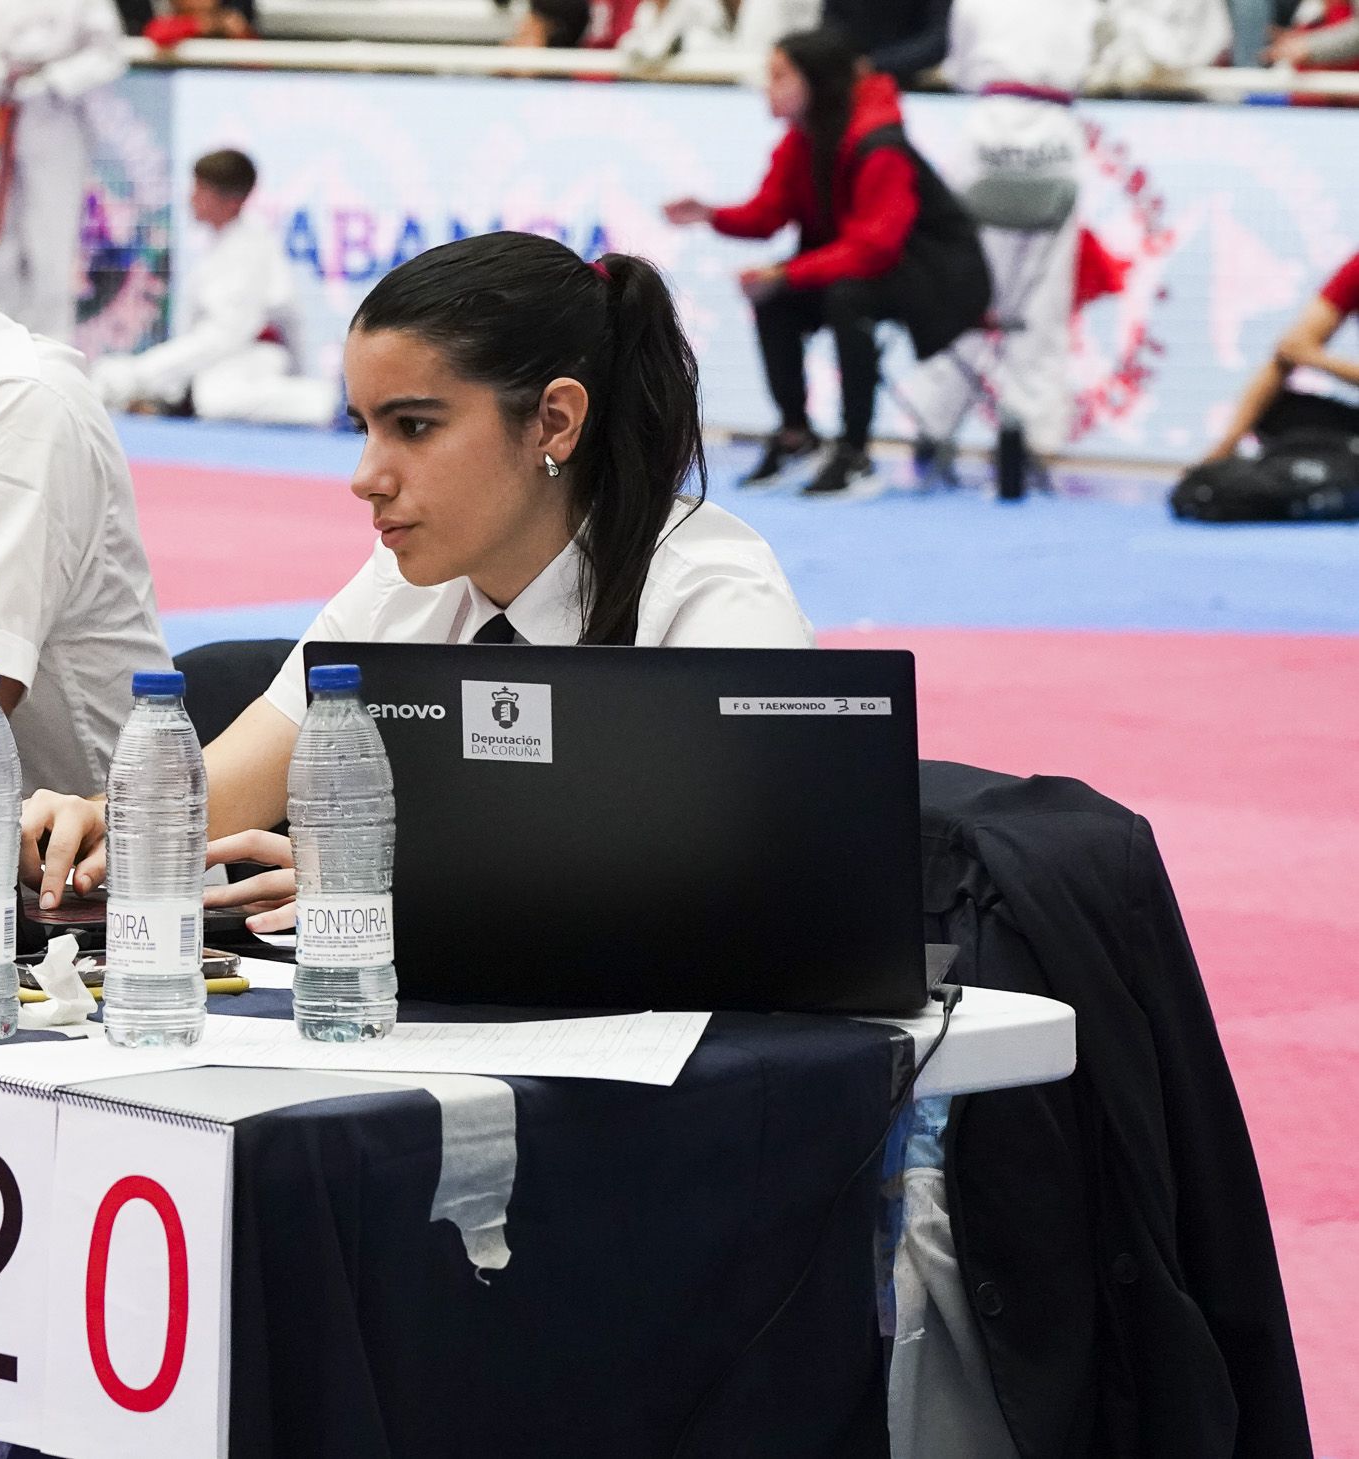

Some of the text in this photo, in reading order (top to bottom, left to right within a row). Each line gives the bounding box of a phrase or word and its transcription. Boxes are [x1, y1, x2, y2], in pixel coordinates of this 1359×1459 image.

[286, 206, 615, 283] ABAA
[366, 703, 446, 720] enovo
[758, 702, 826, 711] TAEKWONDO
[471, 733, 541, 746] Deputación
[471, 744, 541, 757] DA CORUÑA
[307, 906, 388, 934] FONTOIRA
